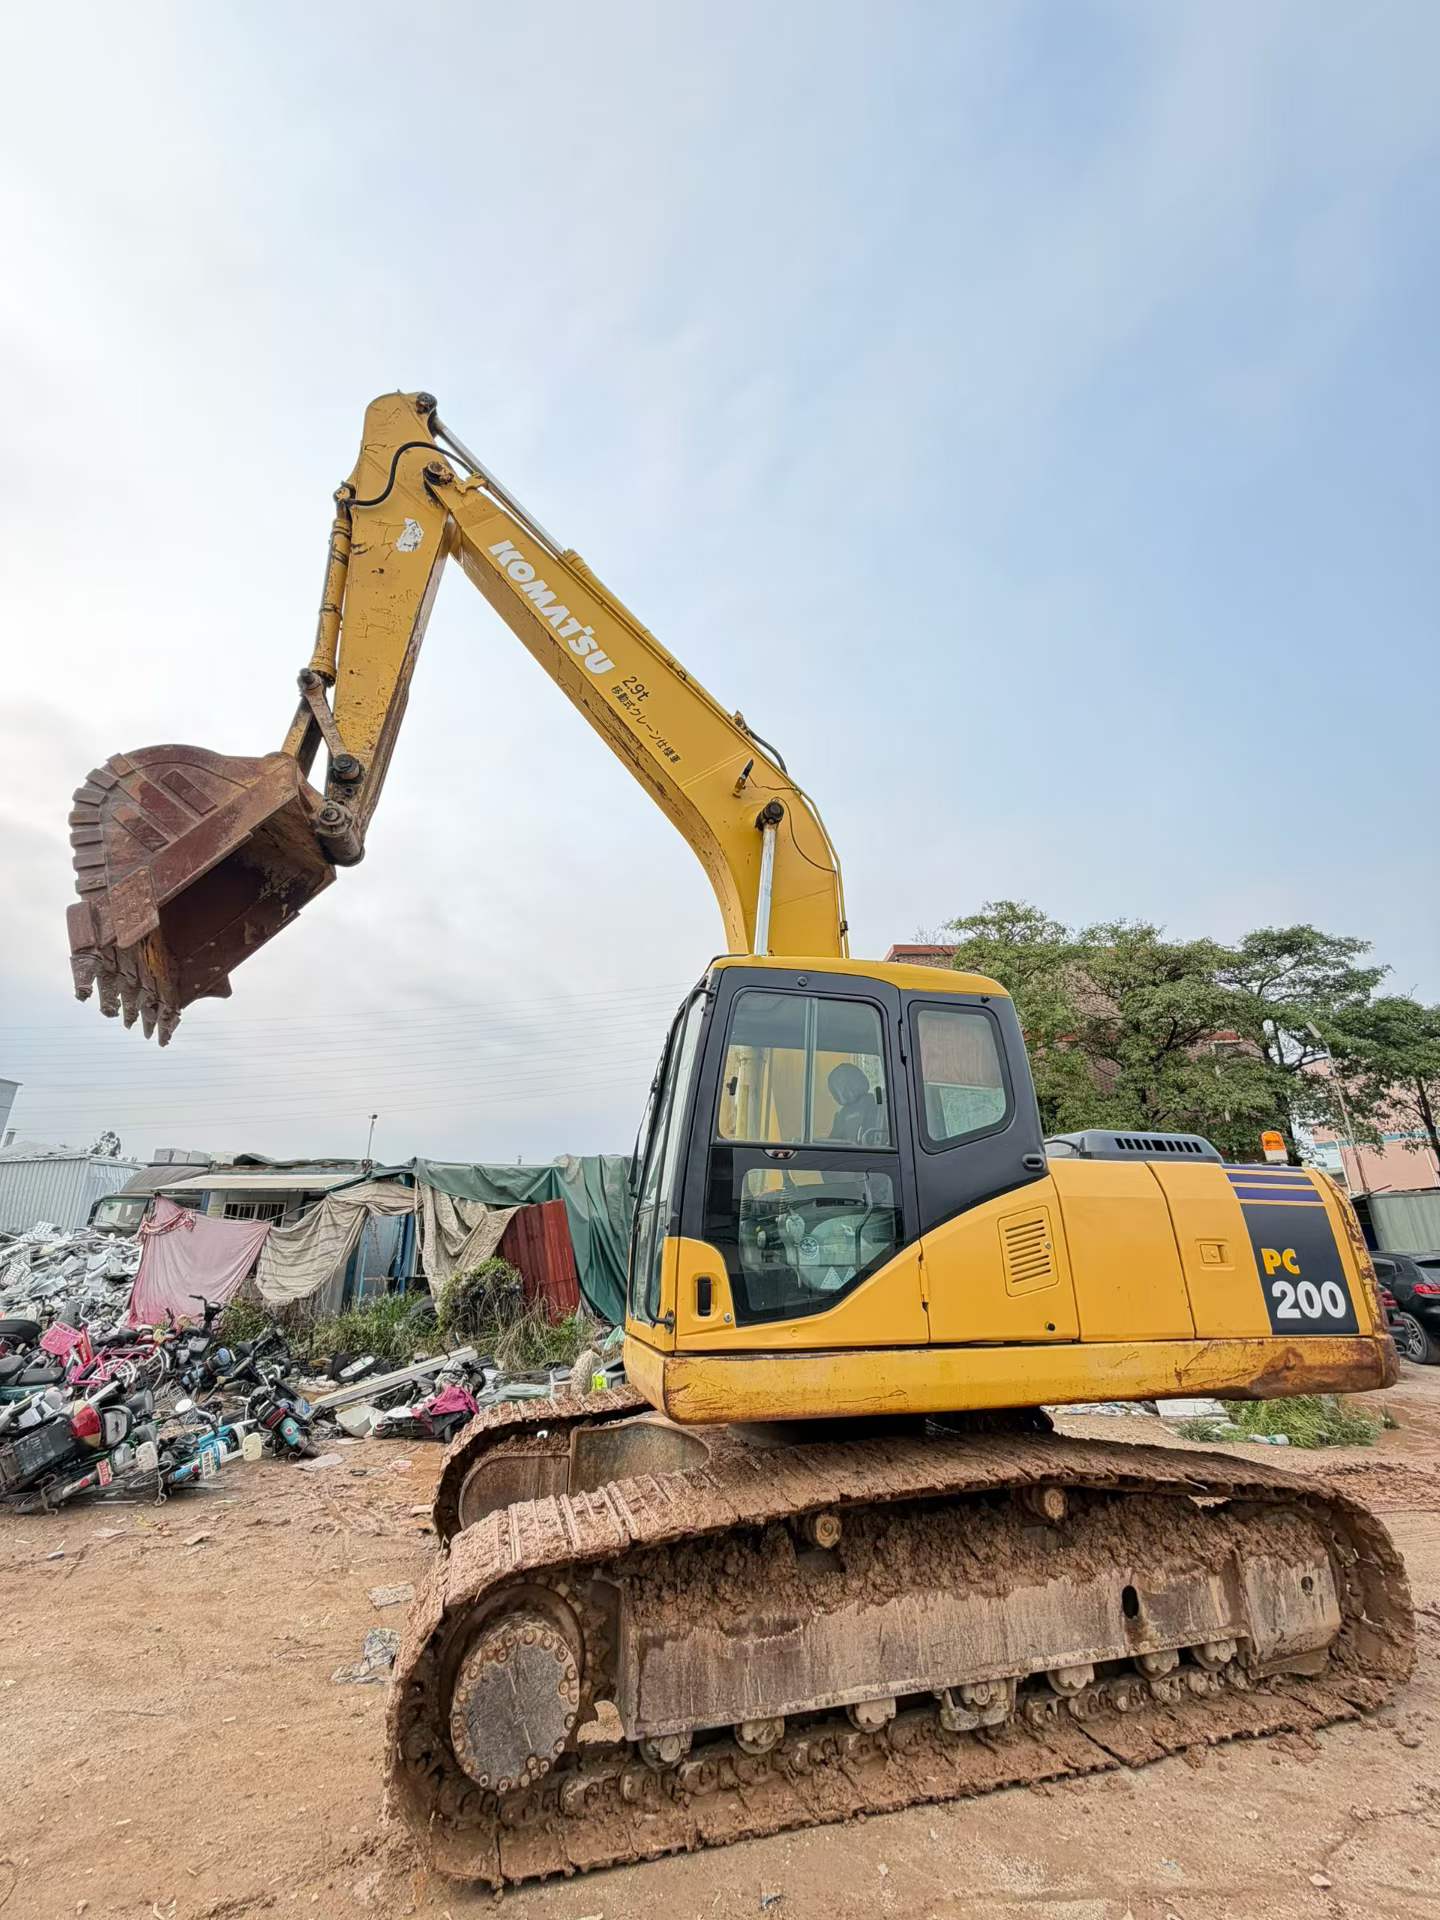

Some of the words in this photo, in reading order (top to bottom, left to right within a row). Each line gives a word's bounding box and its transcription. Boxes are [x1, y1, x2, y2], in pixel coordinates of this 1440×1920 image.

[488, 539, 616, 675] KOMATSU
[1261, 1248, 1301, 1276] PC
[1271, 1280, 1347, 1320] 200
